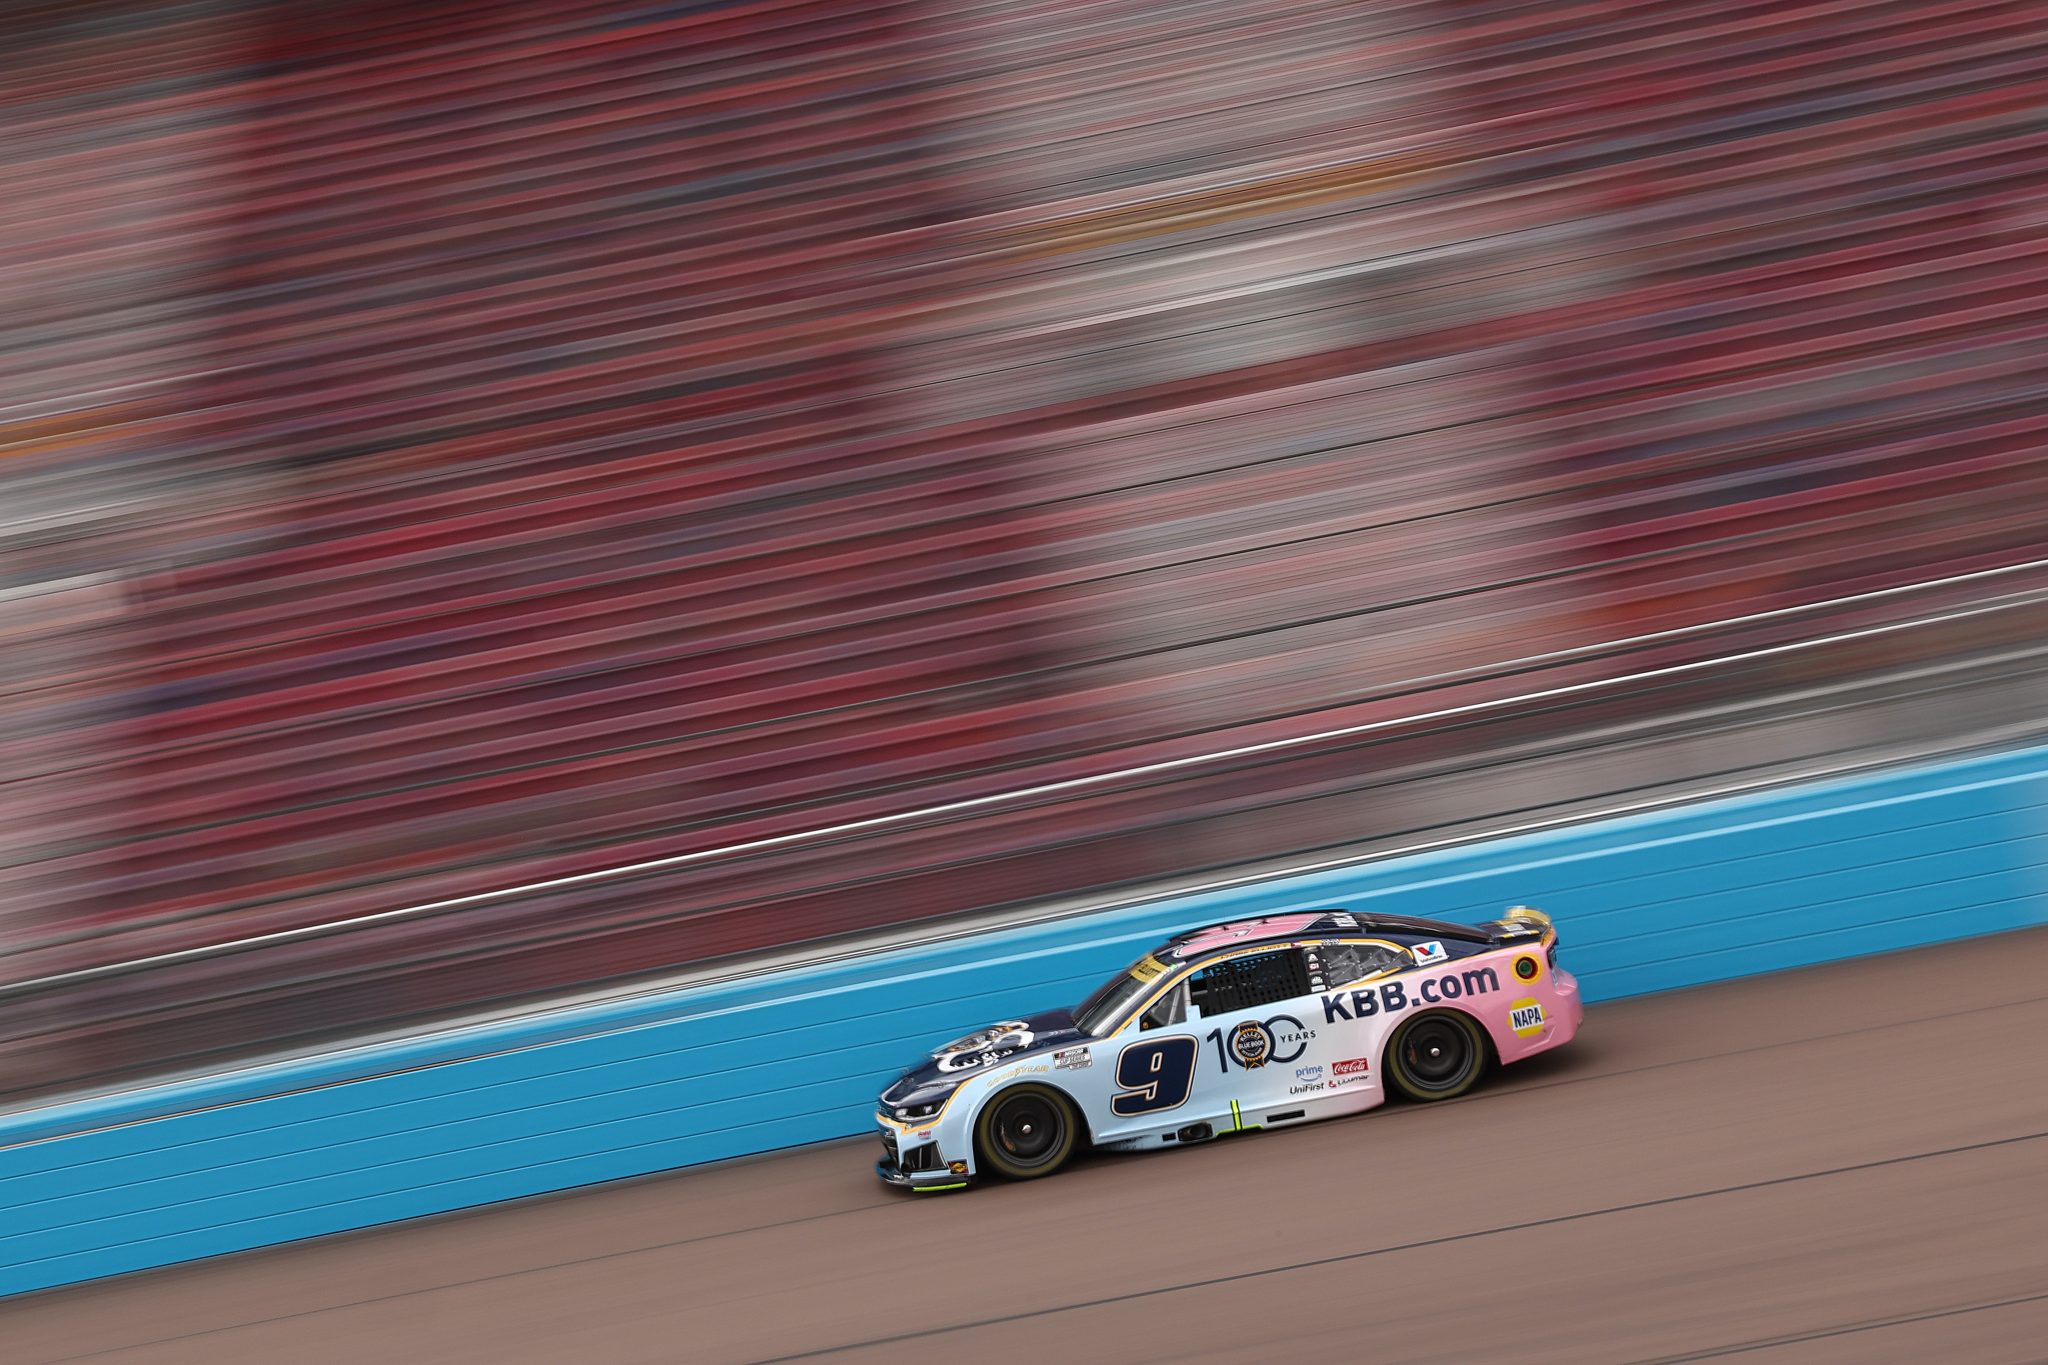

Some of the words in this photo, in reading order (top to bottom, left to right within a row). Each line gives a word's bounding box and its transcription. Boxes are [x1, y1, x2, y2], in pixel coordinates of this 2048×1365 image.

[1321, 967, 1501, 1024] KBB.com
[1512, 1006, 1542, 1029] NAPA
[1206, 1014, 1307, 1074] 100
[1280, 1030, 1316, 1043] YEARS
[1110, 1033, 1199, 1117] 9
[1295, 1065, 1324, 1079] prime
[1289, 1082, 1325, 1095] UniFirst
